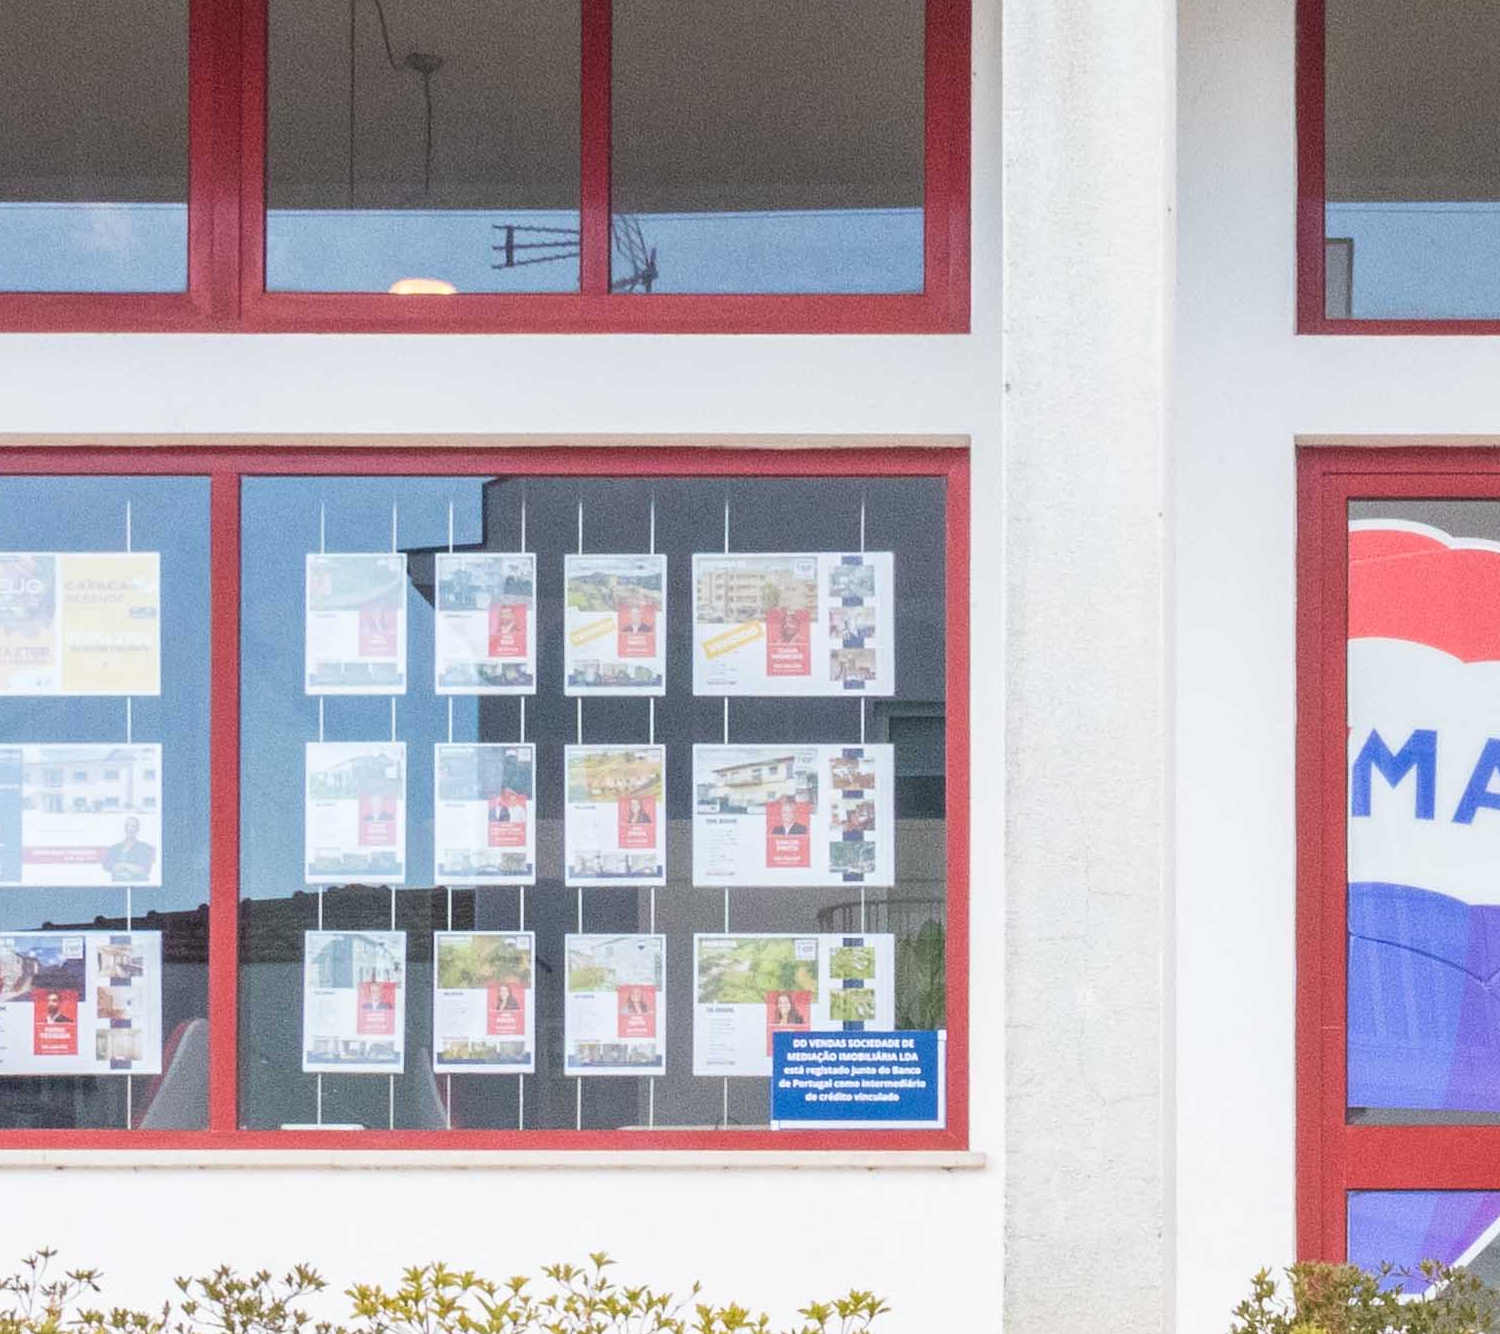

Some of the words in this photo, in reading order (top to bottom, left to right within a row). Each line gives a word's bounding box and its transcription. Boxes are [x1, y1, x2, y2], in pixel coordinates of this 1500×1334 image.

[809, 1039, 846, 1049] VENDAS
[848, 1039, 901, 1049] SOCIEDADE
[902, 1039, 915, 1049] DE
[899, 1052, 919, 1062] LDA
[806, 1065, 850, 1078] registado
[851, 1066, 877, 1077] junto
[878, 1066, 890, 1076] do
[892, 1066, 921, 1076] Banco
[779, 1079, 791, 1089] de
[793, 1079, 832, 1091] Portugal
[833, 1081, 861, 1089] como
[805, 1092, 817, 1102] de
